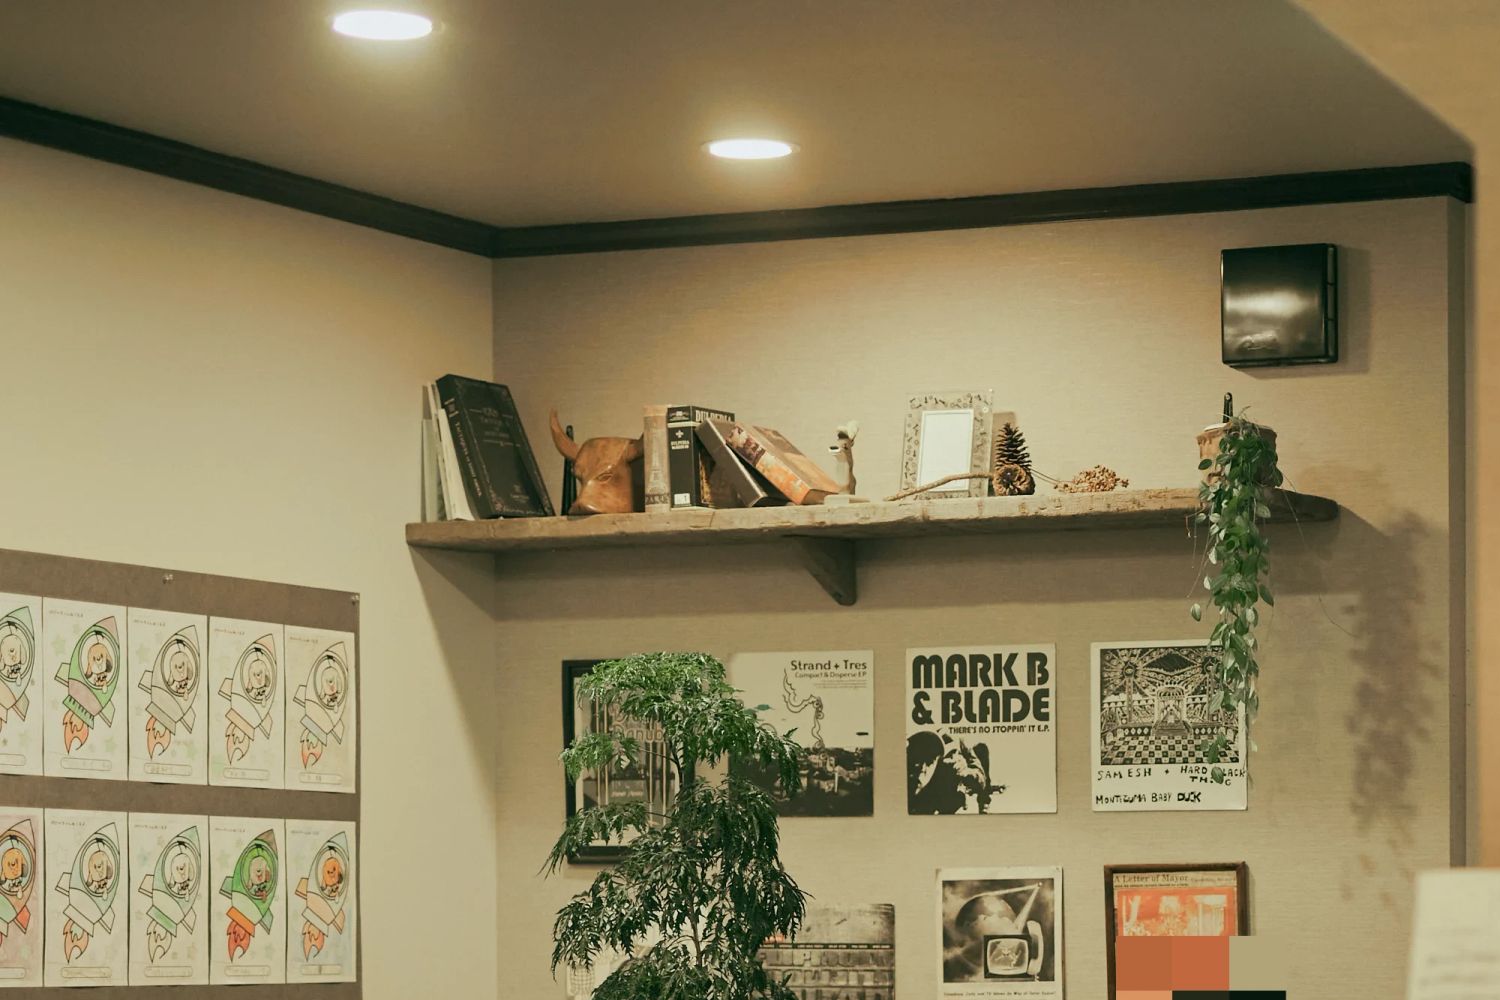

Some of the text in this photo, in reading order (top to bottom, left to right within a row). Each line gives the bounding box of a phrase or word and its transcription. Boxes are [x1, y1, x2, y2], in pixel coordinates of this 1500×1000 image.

[791, 660, 831, 671] Strand
[843, 659, 867, 670] Tres
[912, 652, 1049, 689] MARK B
[911, 688, 1050, 725] & BLADE
[949, 726, 977, 734] THERE'S
[979, 726, 991, 734] NO
[993, 725, 1027, 734] STOPPIN'
[1028, 725, 1036, 733] IT
[1180, 765, 1208, 775] HARD
[1214, 767, 1245, 778] LACK
[1151, 793, 1172, 803] BABY
[1177, 792, 1202, 803] DUCK
[1113, 875, 1121, 883] A
[1122, 874, 1149, 883] Letter
[1151, 874, 1160, 883] of
[1162, 873, 1189, 883] Mayor
